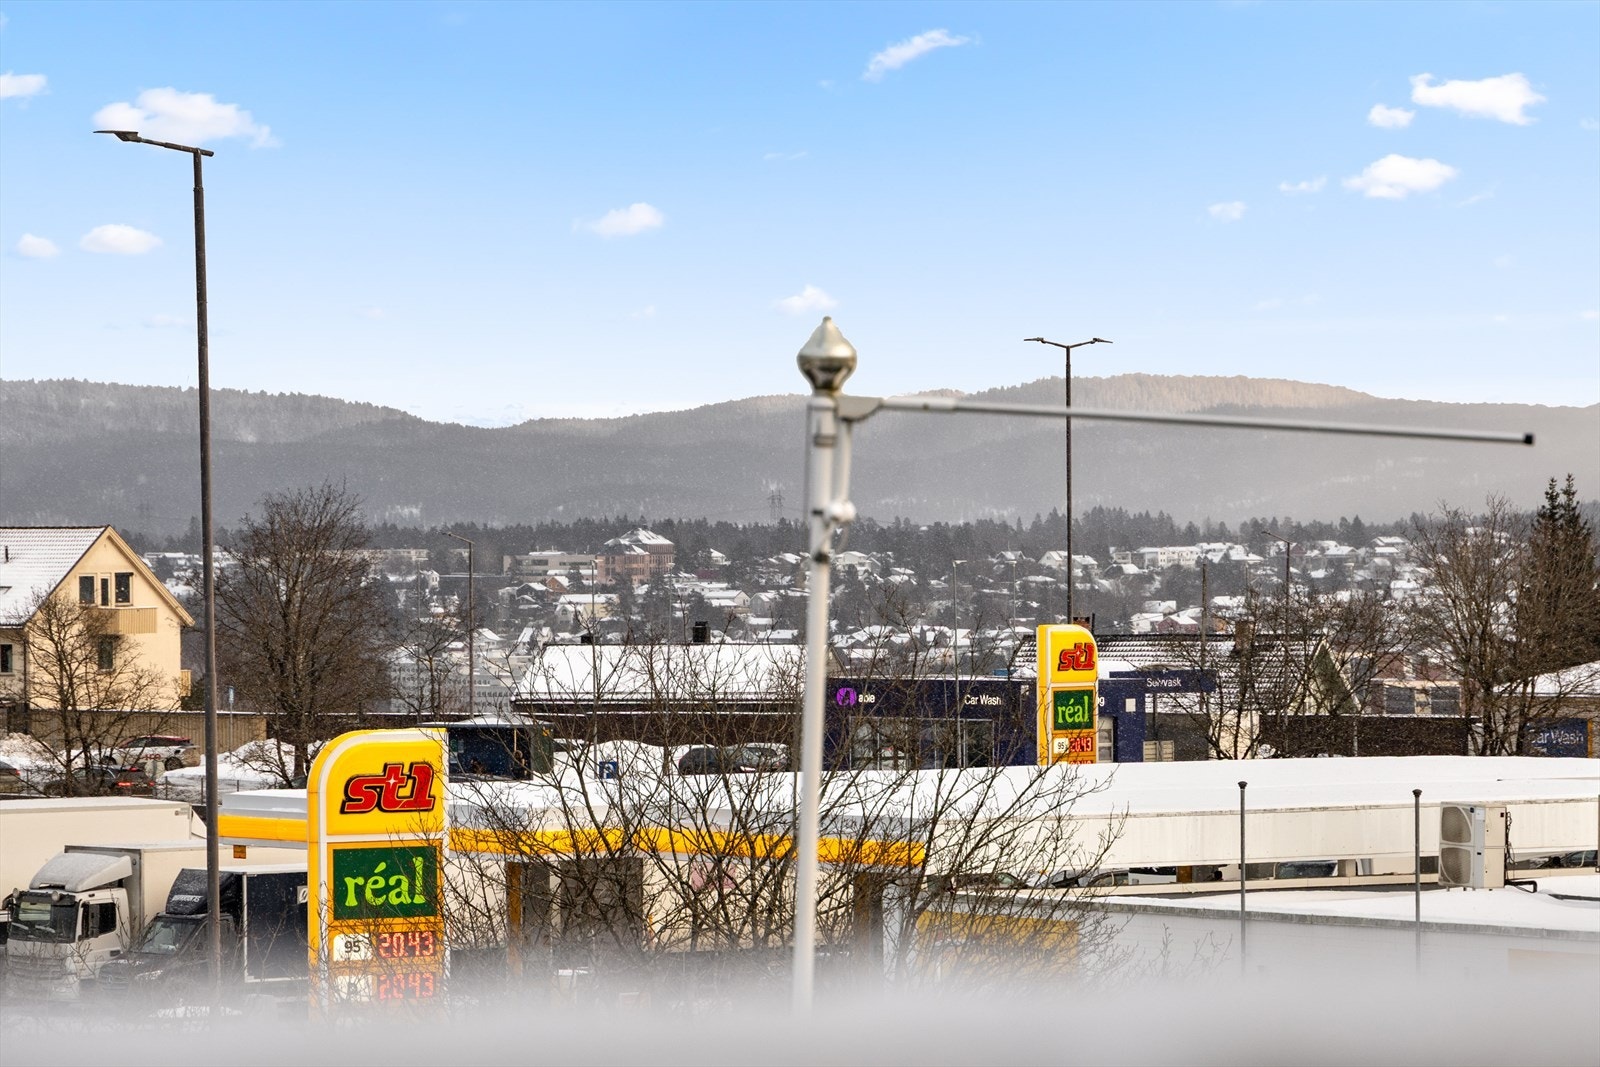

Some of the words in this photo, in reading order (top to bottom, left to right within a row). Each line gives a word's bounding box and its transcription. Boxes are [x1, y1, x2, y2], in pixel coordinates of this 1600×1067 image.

[1058, 642, 1096, 671] st1
[964, 694, 979, 705] Car
[979, 694, 1002, 706] Wash
[1057, 695, 1089, 724] réal
[1057, 741, 1065, 750] 95
[340, 761, 437, 815] st1
[344, 856, 426, 907] réal
[344, 940, 361, 953] 95
